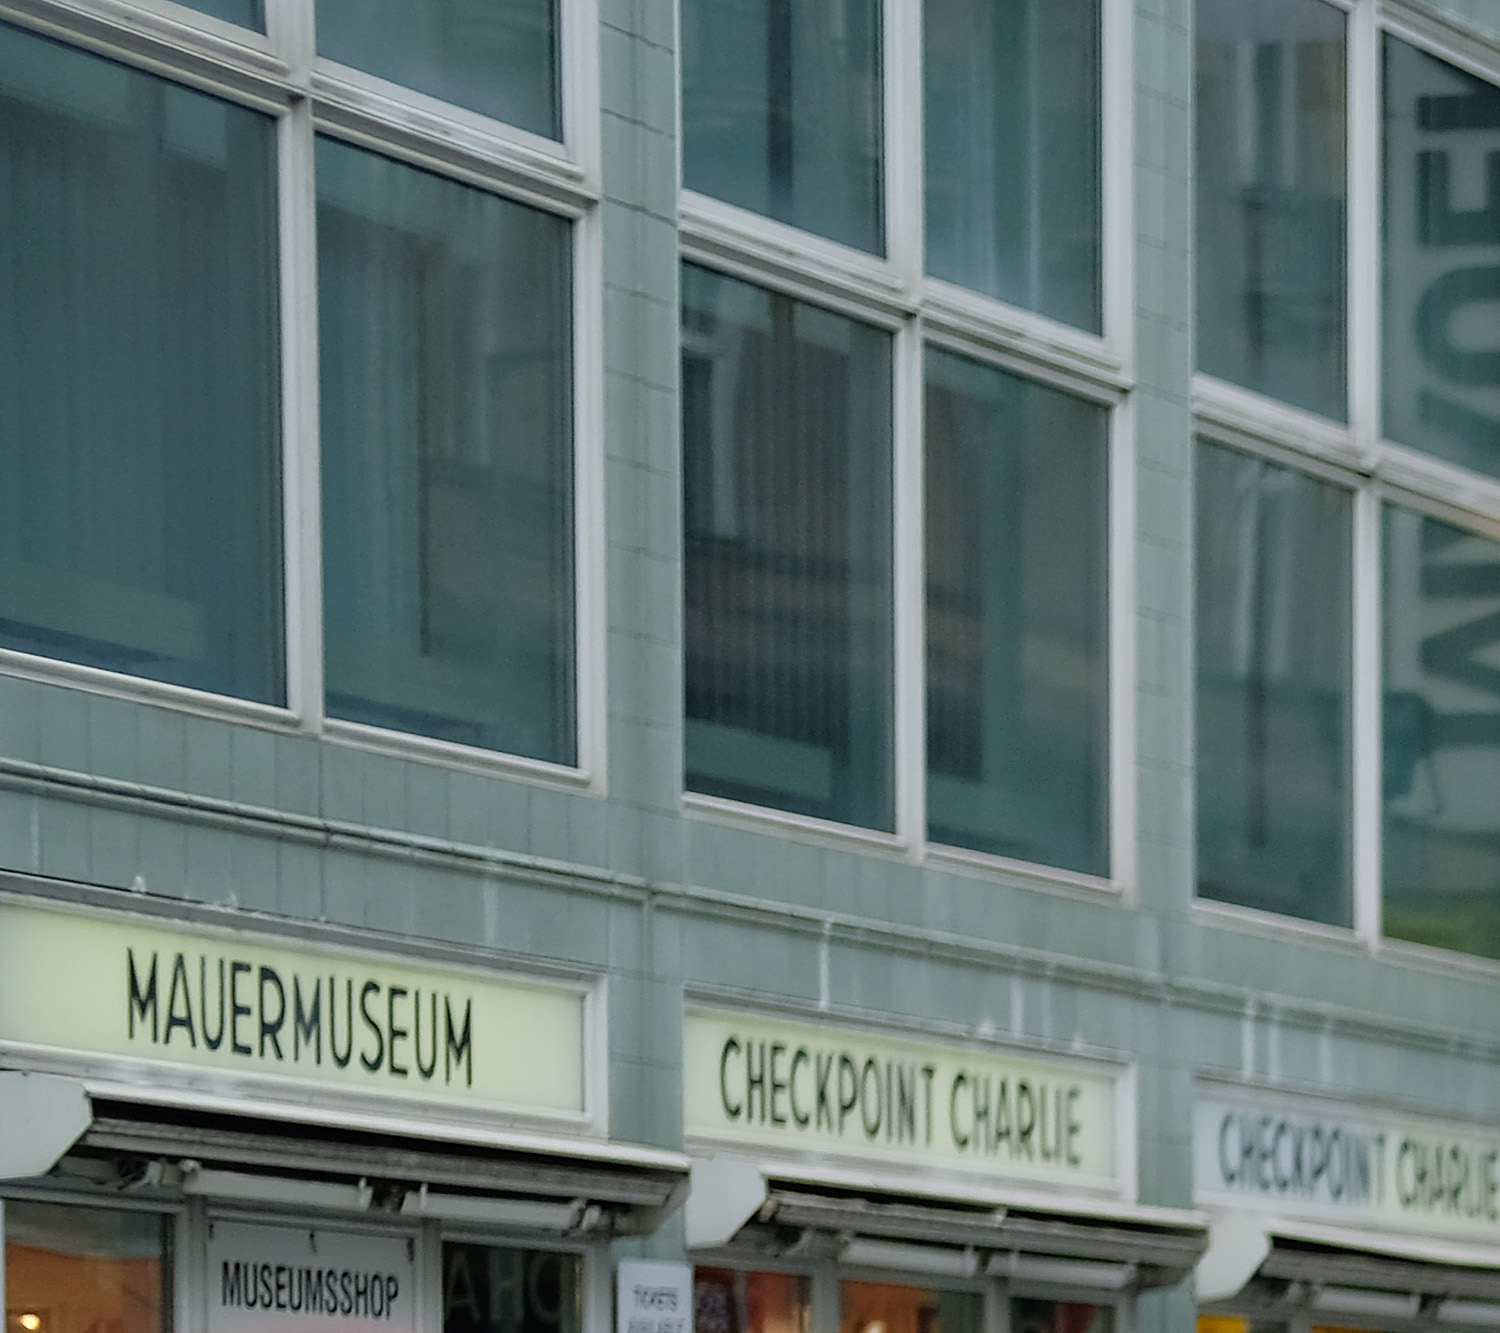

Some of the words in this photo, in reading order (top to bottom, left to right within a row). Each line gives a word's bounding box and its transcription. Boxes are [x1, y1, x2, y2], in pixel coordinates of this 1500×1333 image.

[127, 948, 475, 1087] MAUERMUSEUM
[721, 1034, 933, 1148] CHECKPOINT
[949, 1071, 1084, 1168] CHARLIE
[1218, 1113, 1388, 1211] CHECKPOINT
[221, 1260, 400, 1321] MUSEUMSSHOP
